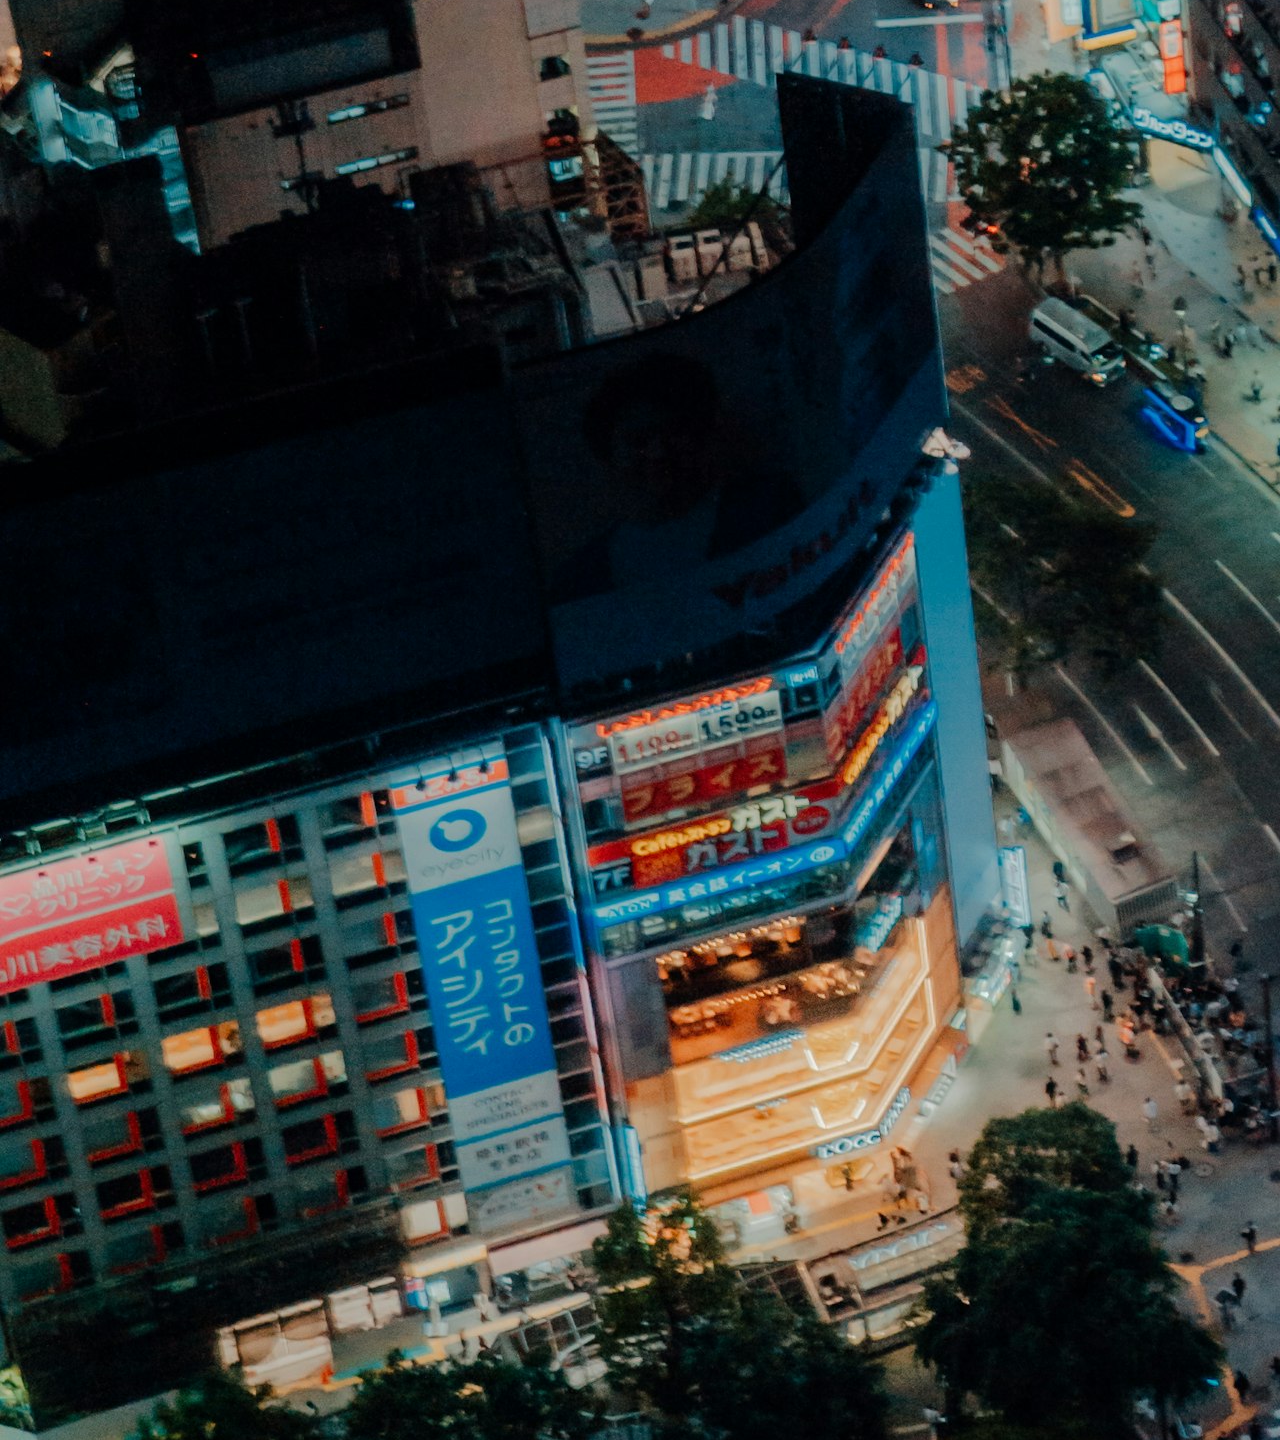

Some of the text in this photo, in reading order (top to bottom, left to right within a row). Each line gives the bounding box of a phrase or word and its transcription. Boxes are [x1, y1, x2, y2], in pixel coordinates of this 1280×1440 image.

[430, 907, 492, 1057] アイシティ
[485, 897, 535, 1047] コンタクトの
